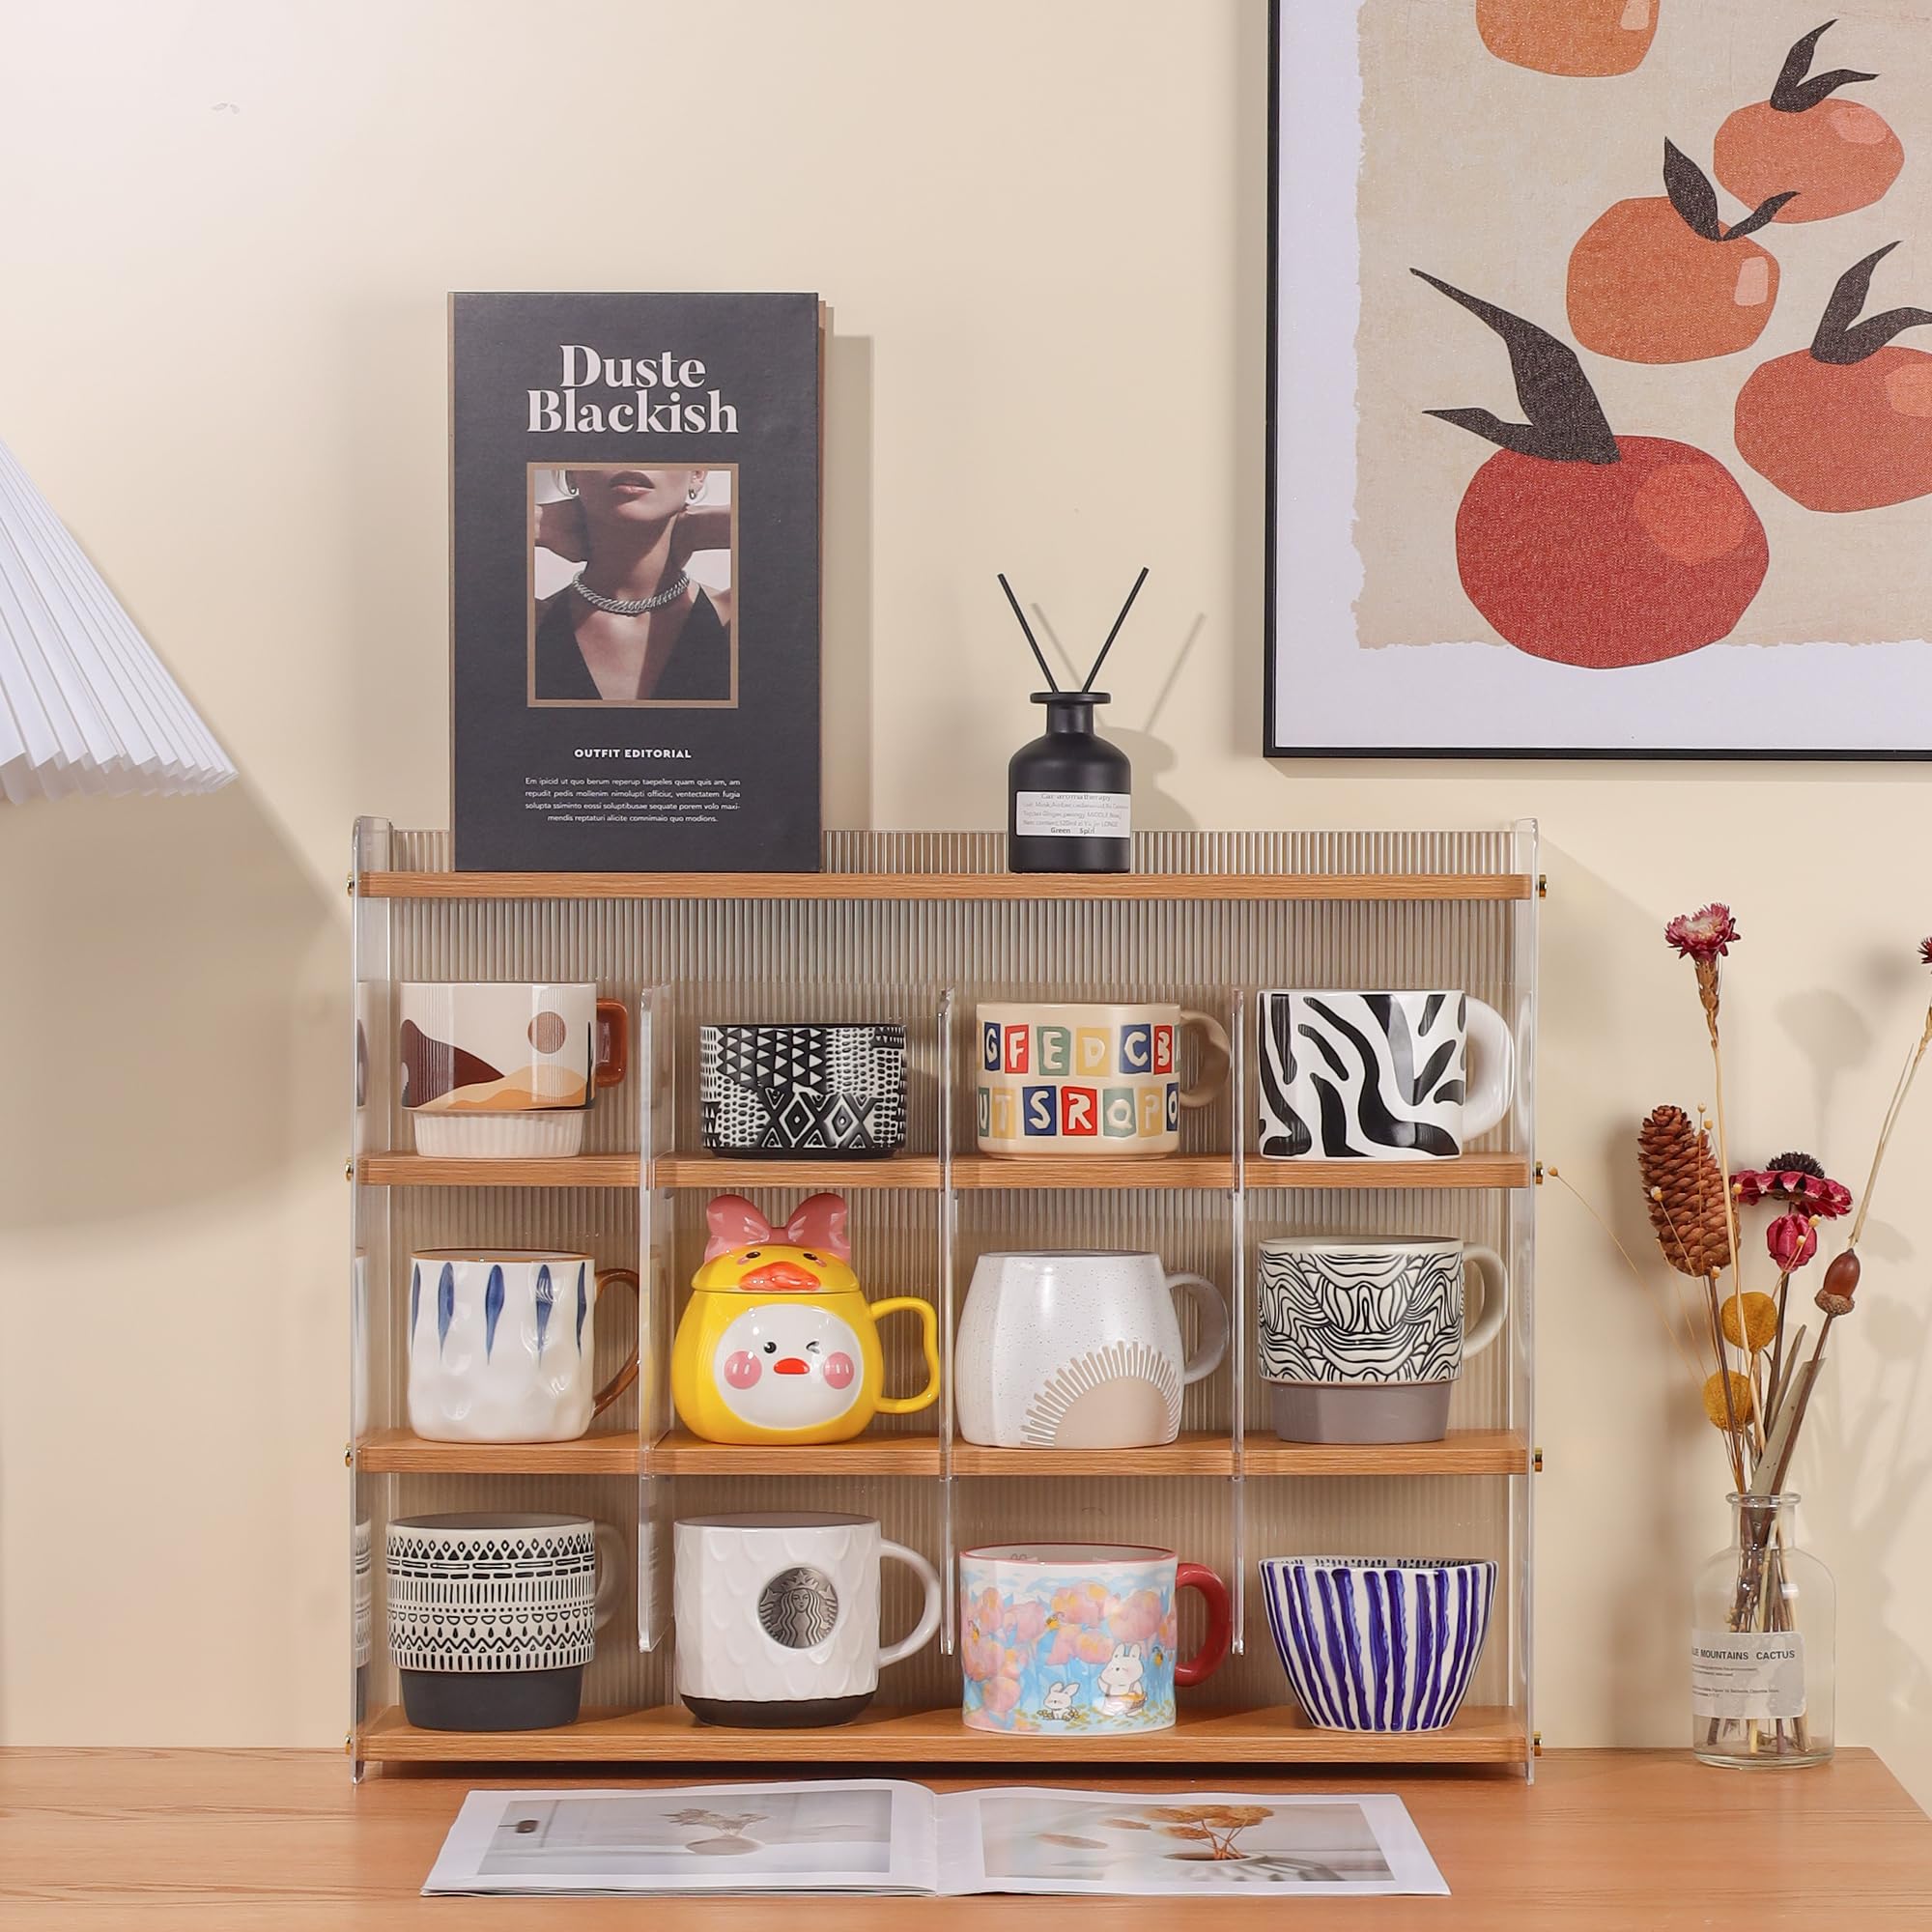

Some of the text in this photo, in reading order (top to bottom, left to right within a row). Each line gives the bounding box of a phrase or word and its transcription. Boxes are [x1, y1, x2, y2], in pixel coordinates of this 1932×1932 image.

[559, 344, 707, 388] Duste
[526, 388, 740, 434] Blackish
[574, 749, 692, 758] OUTFIT EDITORIAL
[525, 777, 538, 785] Em
[538, 777, 559, 786] ipicid
[569, 779, 585, 787] quo
[586, 777, 611, 785] berum
[696, 778, 712, 787] quis
[525, 789, 552, 798] repudit
[553, 789, 574, 799] pedis
[611, 789, 645, 799] nimolupti
[722, 789, 741, 800] fugia
[525, 801, 553, 810] solupta
[648, 803, 678, 811] sequate
[703, 802, 720, 810] volo
[547, 813, 574, 822] mendis
[574, 813, 606, 823] reptaturi
[1700, 1649, 1749, 1661] MOUNTAINS
[1755, 1649, 1796, 1661] CACTUS
